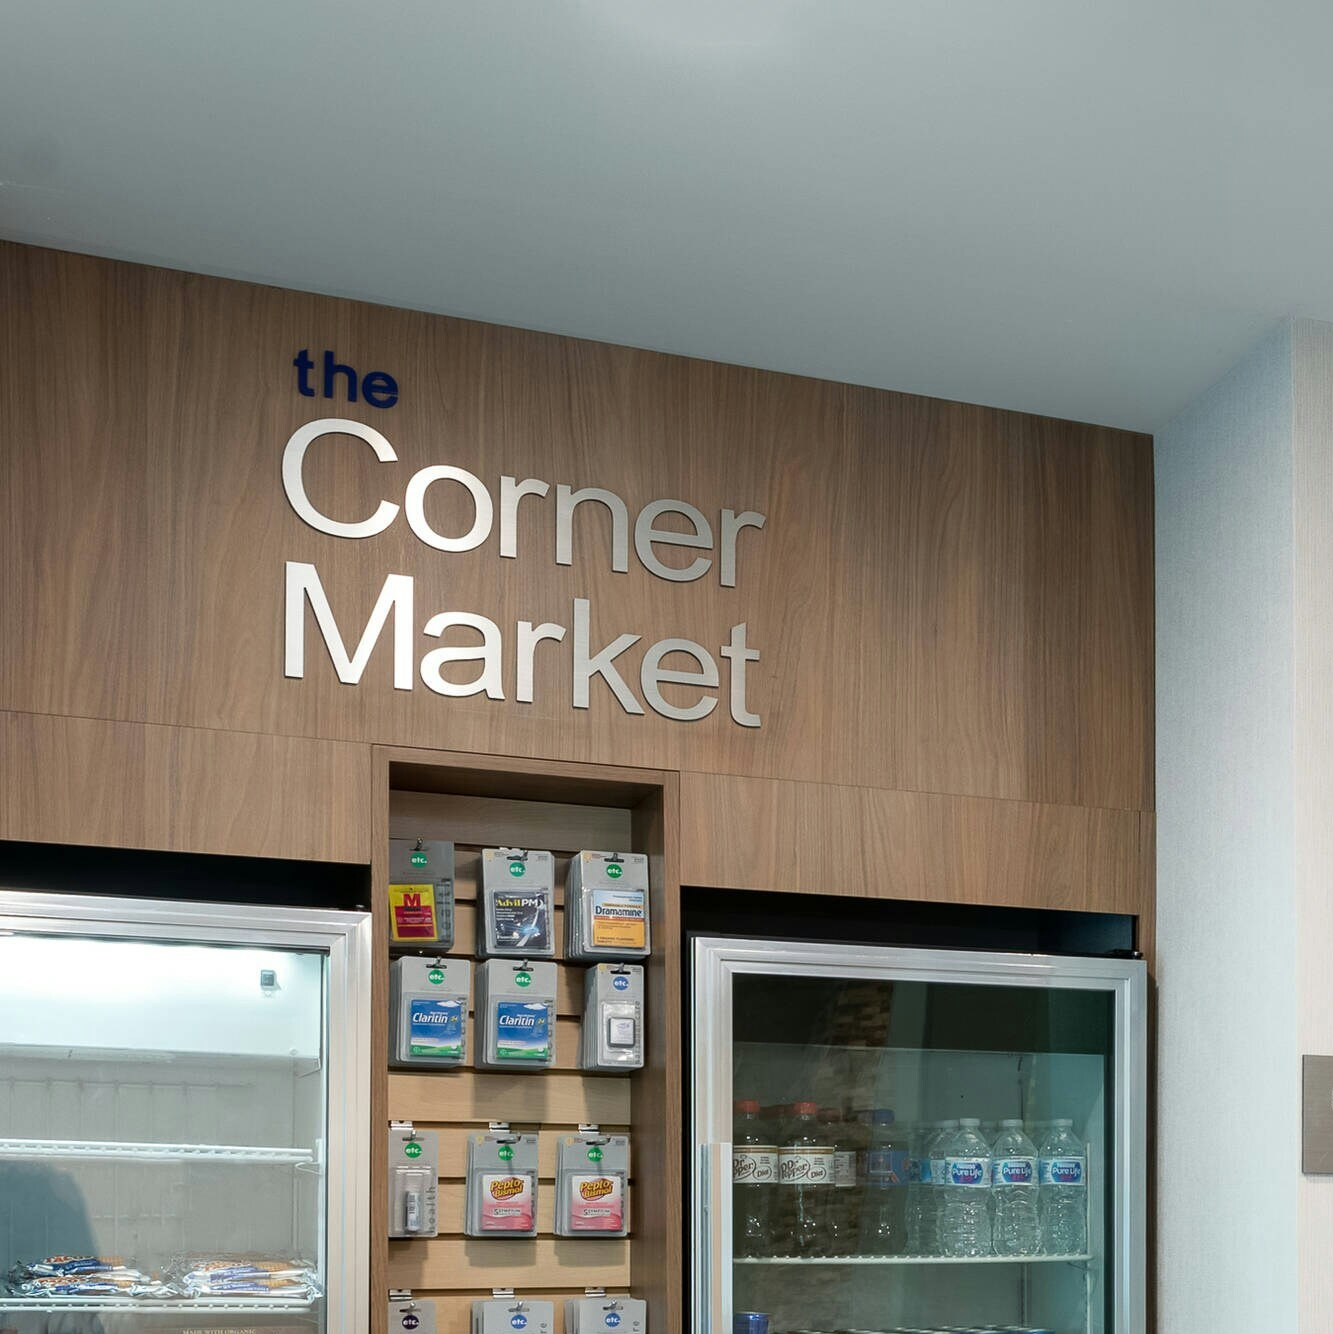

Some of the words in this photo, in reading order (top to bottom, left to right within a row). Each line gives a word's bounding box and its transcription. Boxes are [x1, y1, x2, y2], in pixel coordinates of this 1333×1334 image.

[293, 349, 399, 408] the
[282, 418, 767, 588] Corner
[284, 561, 762, 728] Market
[496, 899, 520, 907] Advil
[521, 899, 538, 907] PM
[595, 905, 642, 917] Dramamine
[413, 1012, 448, 1023] Claritin
[499, 1015, 535, 1026] Claritin
[952, 1168, 968, 1176] Pure
[969, 1168, 982, 1179] Life
[1003, 1167, 1020, 1175] Pure
[1021, 1167, 1032, 1178] Life
[1052, 1167, 1069, 1175] Pure
[1070, 1167, 1081, 1178] Life
